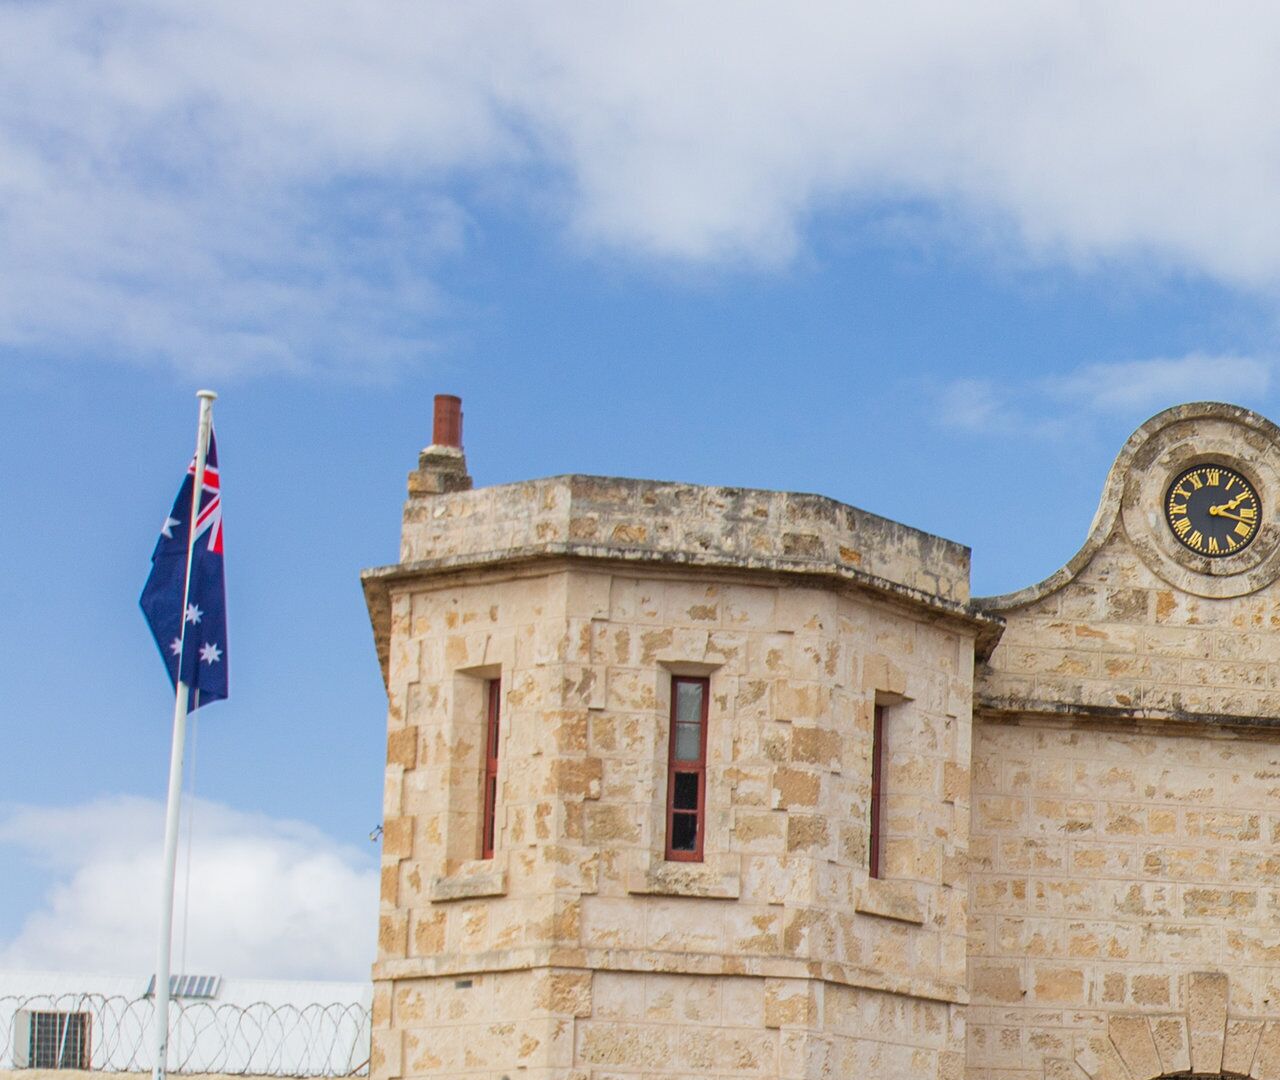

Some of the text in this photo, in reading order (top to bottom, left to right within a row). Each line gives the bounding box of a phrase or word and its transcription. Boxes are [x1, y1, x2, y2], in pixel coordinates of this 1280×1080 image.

[1189, 474, 1203, 490] XI
[1206, 471, 1220, 486] XII
[1225, 475, 1236, 490] I
[1175, 486, 1191, 500] X
[1171, 503, 1187, 514] IX
[1188, 530, 1203, 549] VII
[1208, 536, 1220, 551] VI
[1226, 534, 1237, 549] V
